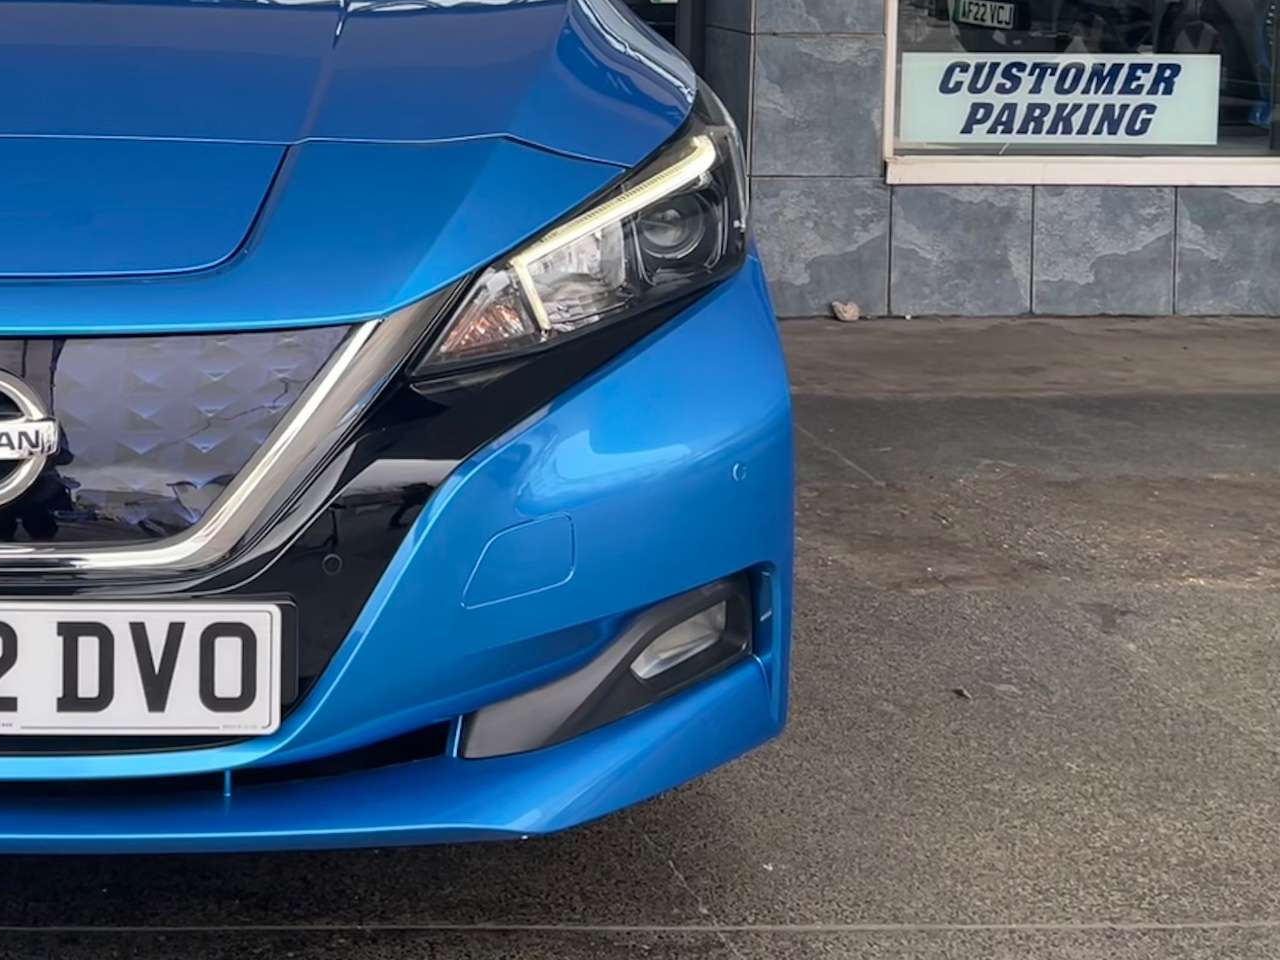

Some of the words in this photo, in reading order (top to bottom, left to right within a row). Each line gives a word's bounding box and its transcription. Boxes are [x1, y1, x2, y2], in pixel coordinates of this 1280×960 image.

[938, 61, 1182, 96] CUSTOMER
[960, 102, 1157, 137] PARKING
[55, 620, 258, 714] DVO
